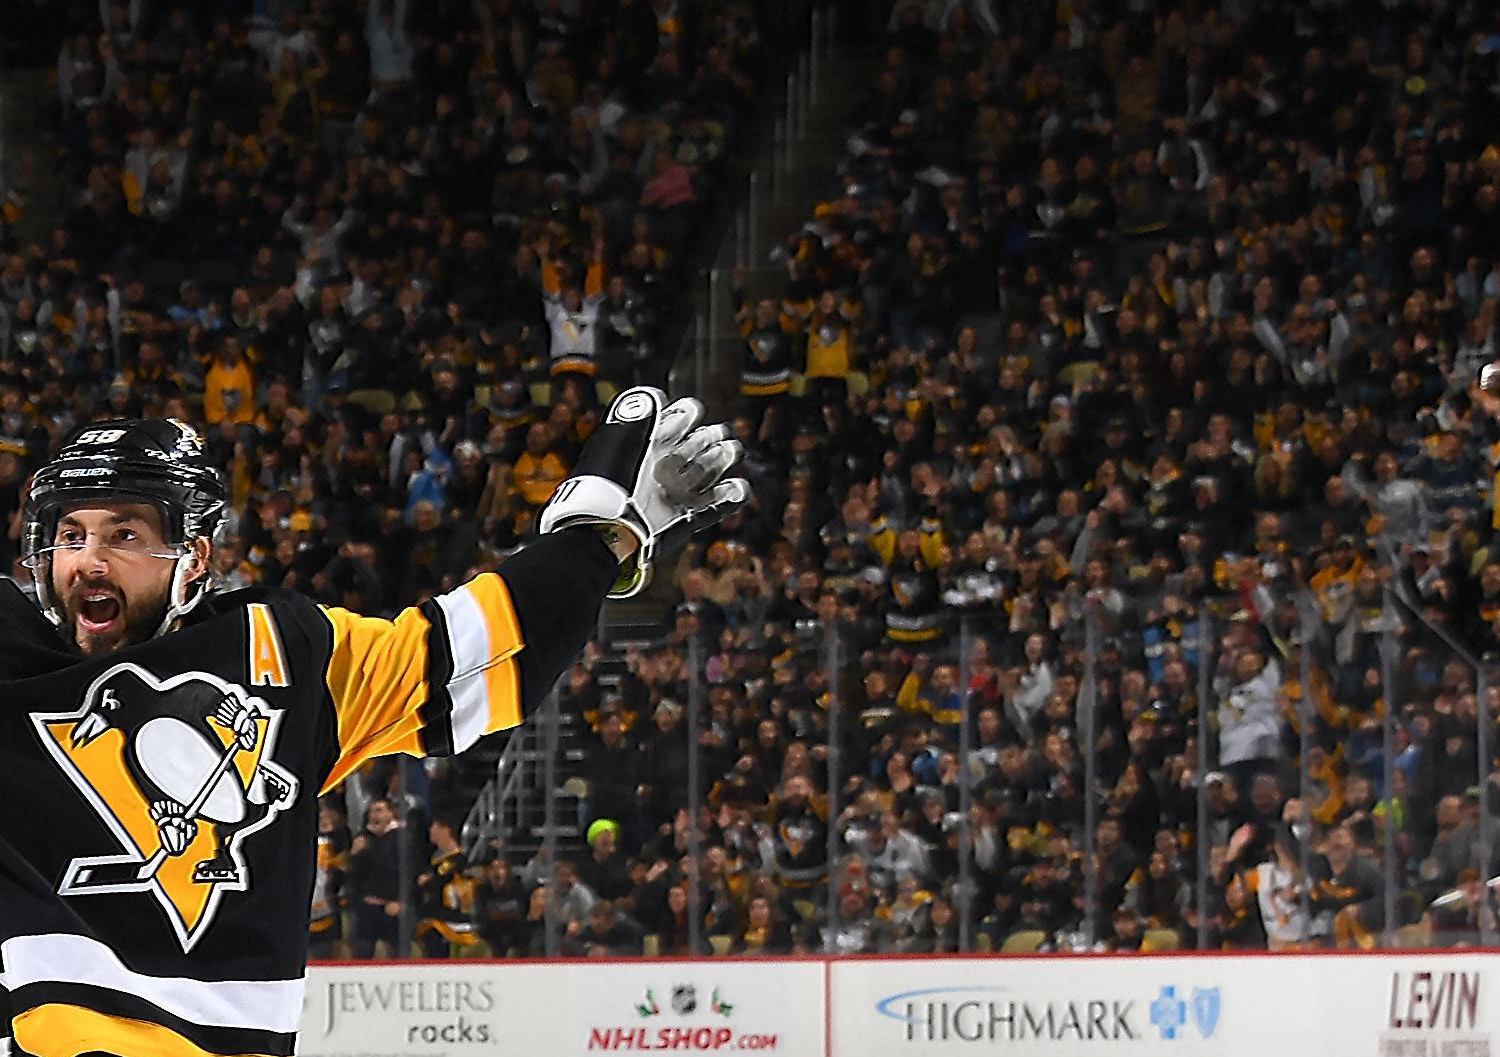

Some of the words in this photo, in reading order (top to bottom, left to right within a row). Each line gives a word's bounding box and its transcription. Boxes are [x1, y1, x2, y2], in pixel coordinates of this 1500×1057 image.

[76, 429, 127, 444] 58
[247, 603, 292, 687] A
[326, 979, 495, 1039] JEWELERS
[906, 1000, 1134, 1041] HIGHMARK
[1389, 972, 1480, 1029] LEVIN
